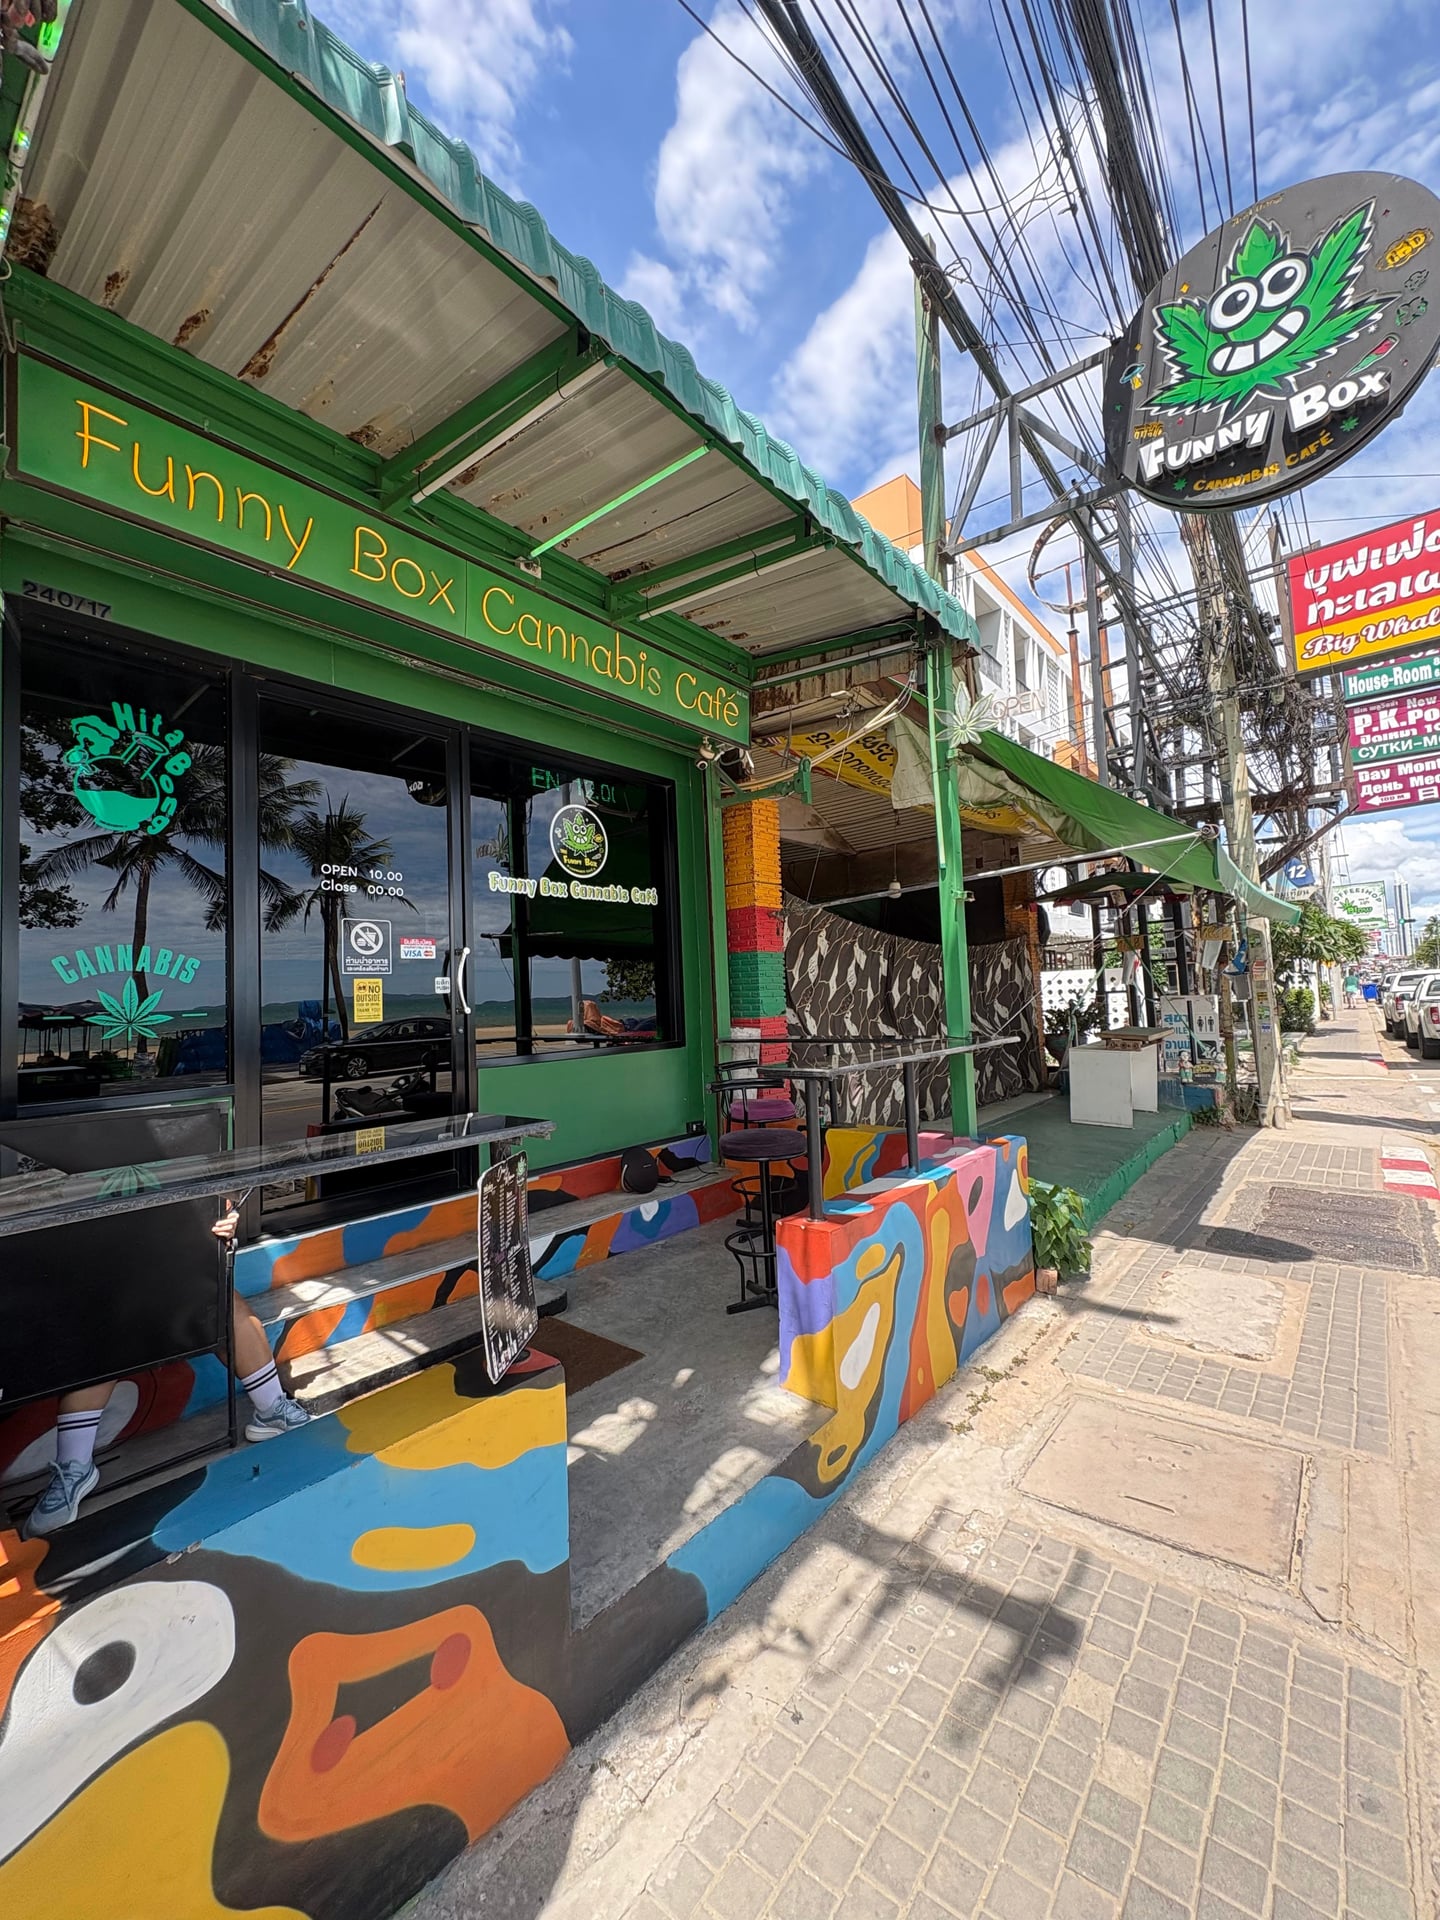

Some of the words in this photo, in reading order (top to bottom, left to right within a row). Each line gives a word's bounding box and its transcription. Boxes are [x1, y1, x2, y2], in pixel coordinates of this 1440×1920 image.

[1192, 462, 1282, 493] CANNABIS
[74, 398, 314, 570] Funny
[350, 525, 457, 616] Box
[481, 586, 663, 698] Cannabis
[675, 671, 741, 728] Café
[23, 581, 112, 618] 240/17
[1302, 632, 1360, 660] Big
[1348, 664, 1433, 696] House-Room
[992, 690, 1046, 719] OPEN
[1406, 695, 1438, 710] New
[1358, 734, 1440, 759] СУТКИ-М
[112, 702, 163, 734] Hit
[147, 751, 192, 836] Bong
[1358, 767, 1391, 783] Day
[1360, 780, 1404, 798] День
[321, 864, 358, 878] OPEN
[369, 869, 404, 882] 10.00
[1287, 865, 1307, 879] 12
[321, 879, 358, 894] Close
[367, 885, 404, 898] 00.00
[488, 871, 537, 899] Funny
[540, 877, 568, 898] Box
[569, 880, 629, 903] Cannabis
[631, 886, 658, 906] Café
[51, 944, 200, 985] CANNABIS
[403, 949, 422, 958] VISA
[356, 994, 381, 1002] OUTSIDE
[368, 985, 381, 994] NO
